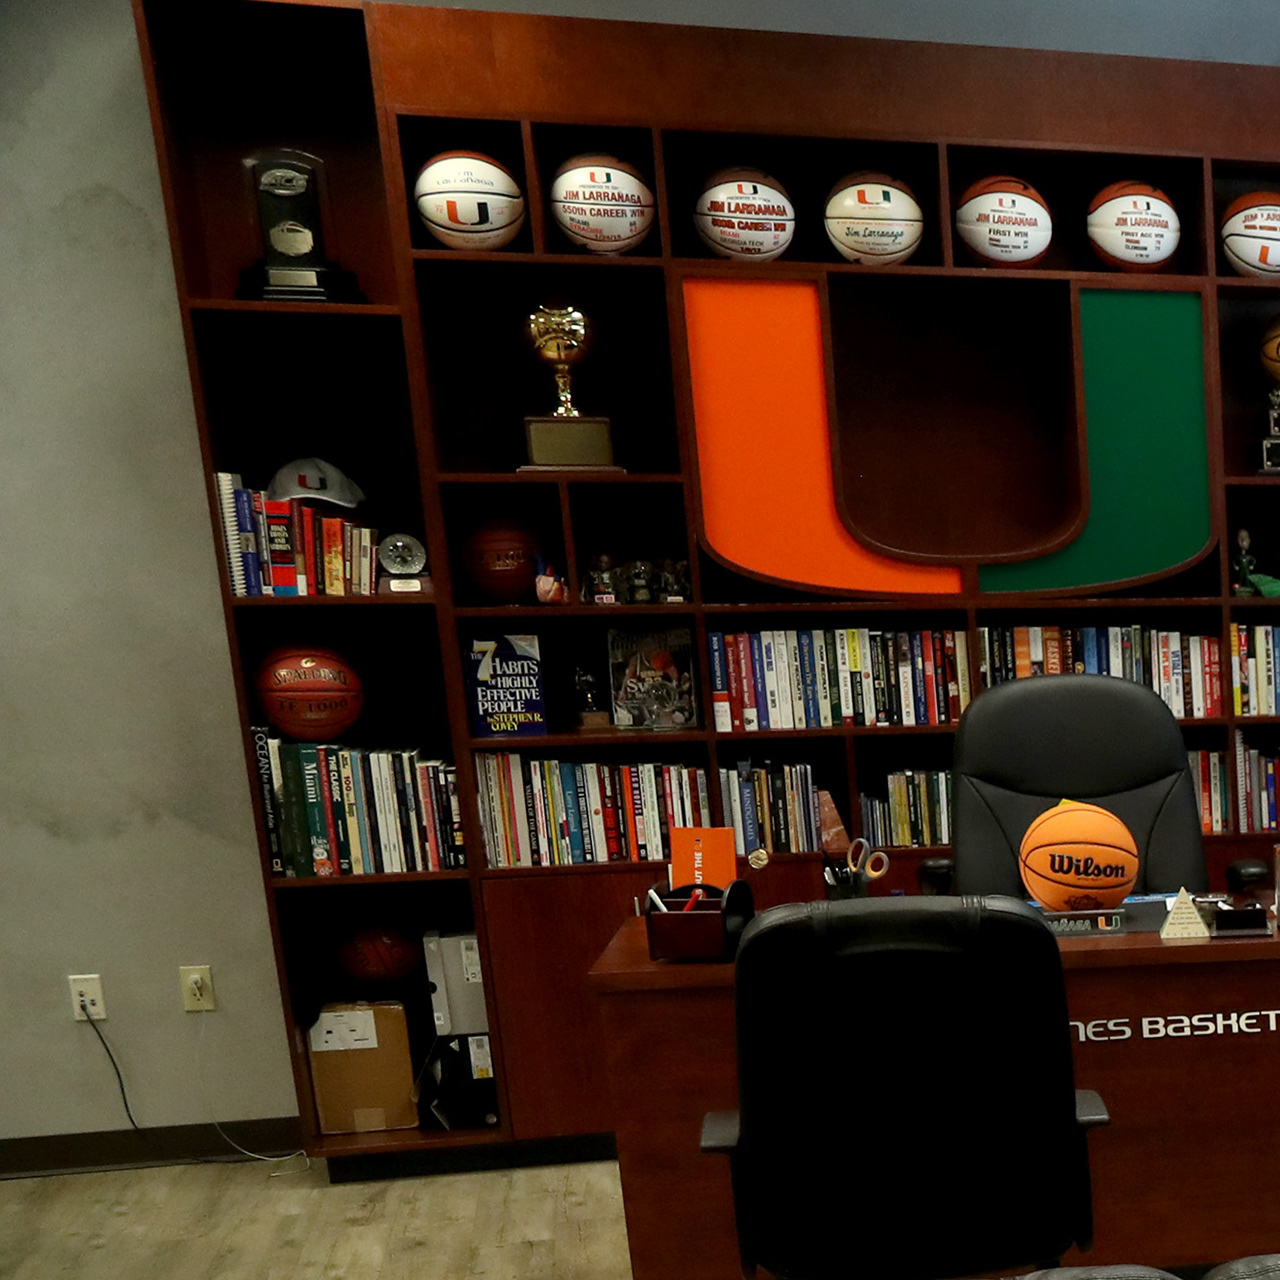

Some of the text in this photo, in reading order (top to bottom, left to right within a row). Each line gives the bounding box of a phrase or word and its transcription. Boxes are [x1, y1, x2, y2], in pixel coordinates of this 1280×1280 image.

[563, 190, 579, 200] JIM
[590, 208, 627, 217] CAREER
[630, 209, 645, 218] WIN
[708, 200, 725, 213] JIM
[976, 213, 990, 222] JIM
[1115, 217, 1128, 226] JIM
[1242, 213, 1258, 223] JIM
[845, 227, 860, 237] Jim
[988, 228, 1011, 236] FIRST
[298, 474, 328, 490] U
[472, 639, 539, 682] 7 HABITS
[712, 636, 722, 690] BOB WOODWARD
[273, 669, 348, 686] SPALDING
[497, 676, 539, 688] HIGHLY
[794, 664, 803, 701] RECRUITS
[820, 663, 828, 700] RECRUITS
[476, 687, 540, 701] EFFECTIVE
[478, 701, 526, 716] PEOPLE
[490, 722, 519, 731] COVEY
[254, 733, 271, 774] OCEAN
[303, 762, 318, 803] Miami
[328, 755, 342, 802] THE CLASSIC
[344, 775, 352, 792] 100
[743, 788, 754, 840] MINDGAMES
[694, 852, 703, 868] THE
[1049, 853, 1125, 878] Wilson
